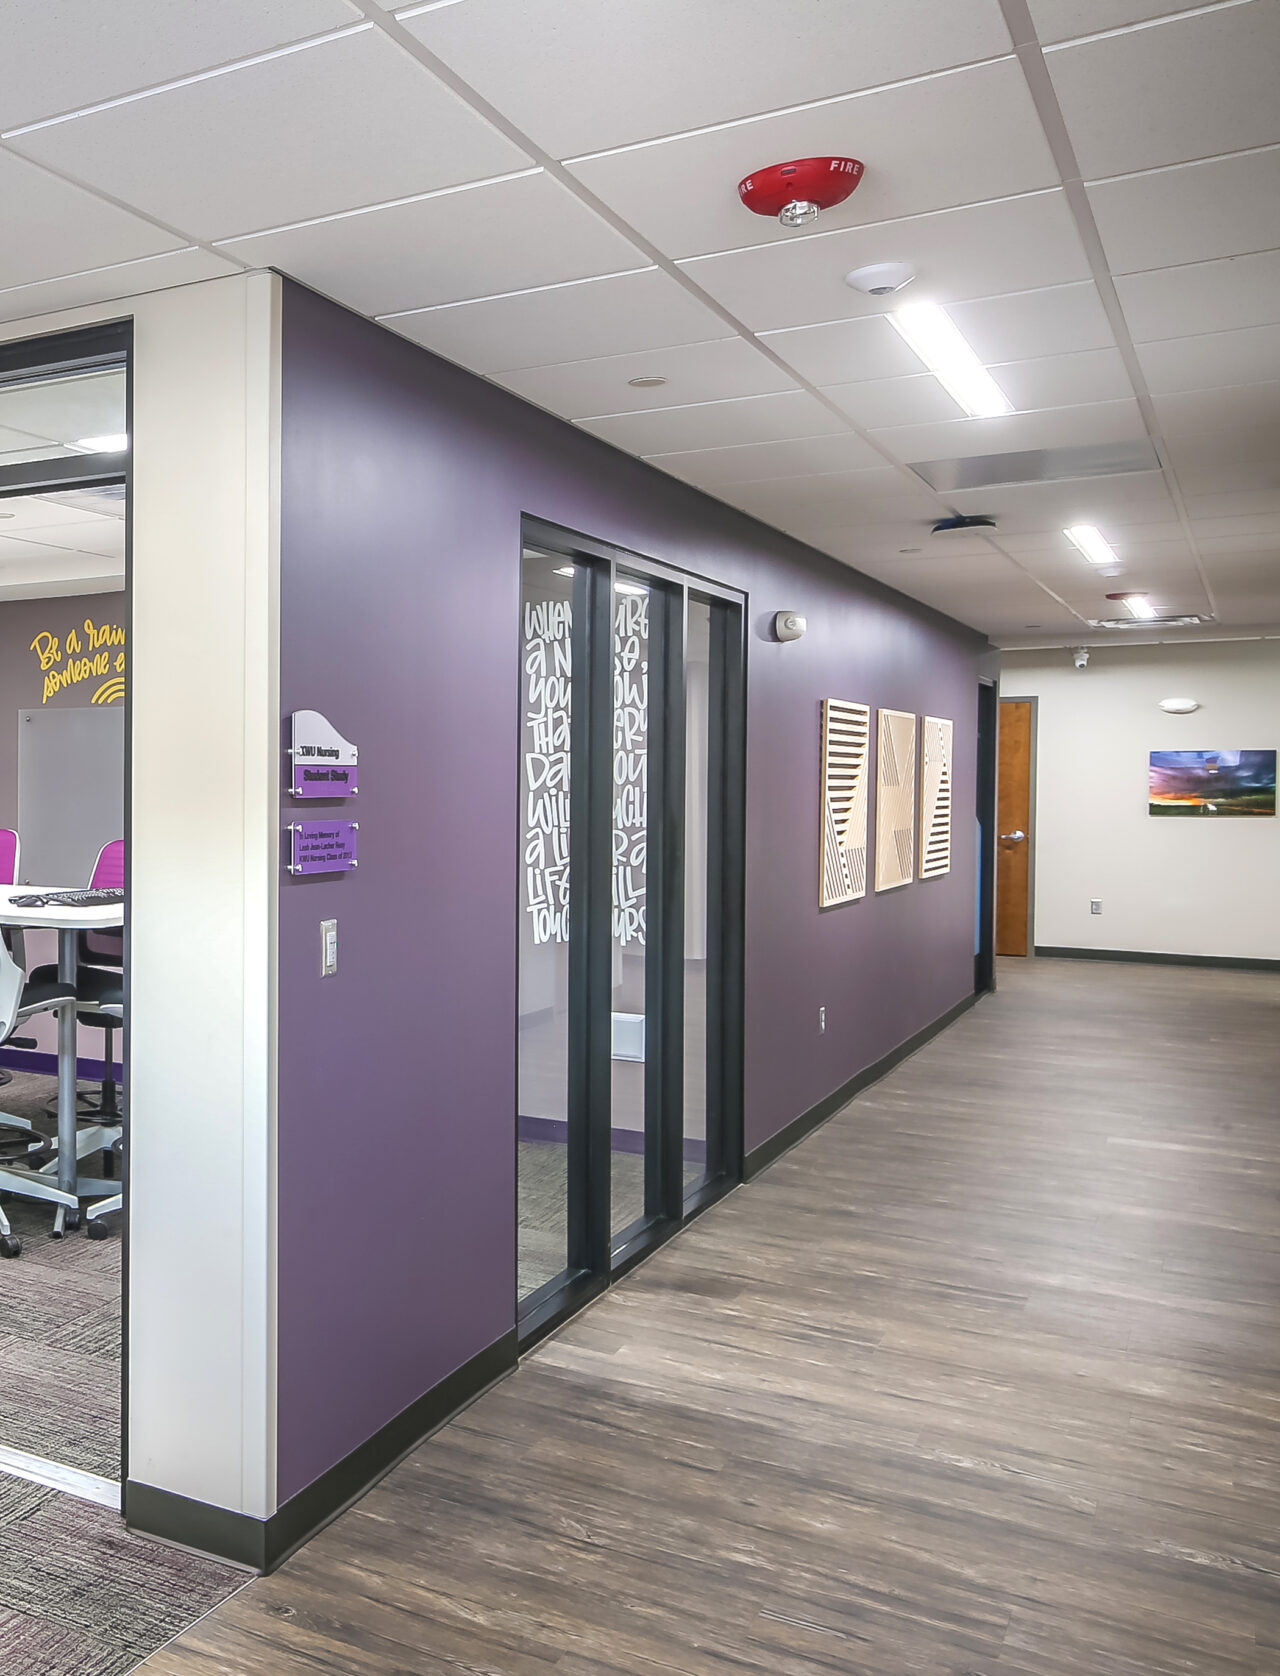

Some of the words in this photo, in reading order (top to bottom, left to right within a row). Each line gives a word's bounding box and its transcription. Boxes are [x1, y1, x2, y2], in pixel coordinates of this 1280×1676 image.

[829, 160, 860, 175] FIRE
[740, 179, 754, 195] RE
[29, 631, 62, 670] Be
[65, 628, 81, 654] a
[83, 618, 125, 651] rain
[42, 651, 110, 704] someone
[316, 746, 340, 760] Nursing
[303, 769, 330, 782] Student
[330, 769, 350, 784] Study
[318, 831, 335, 839] Memory
